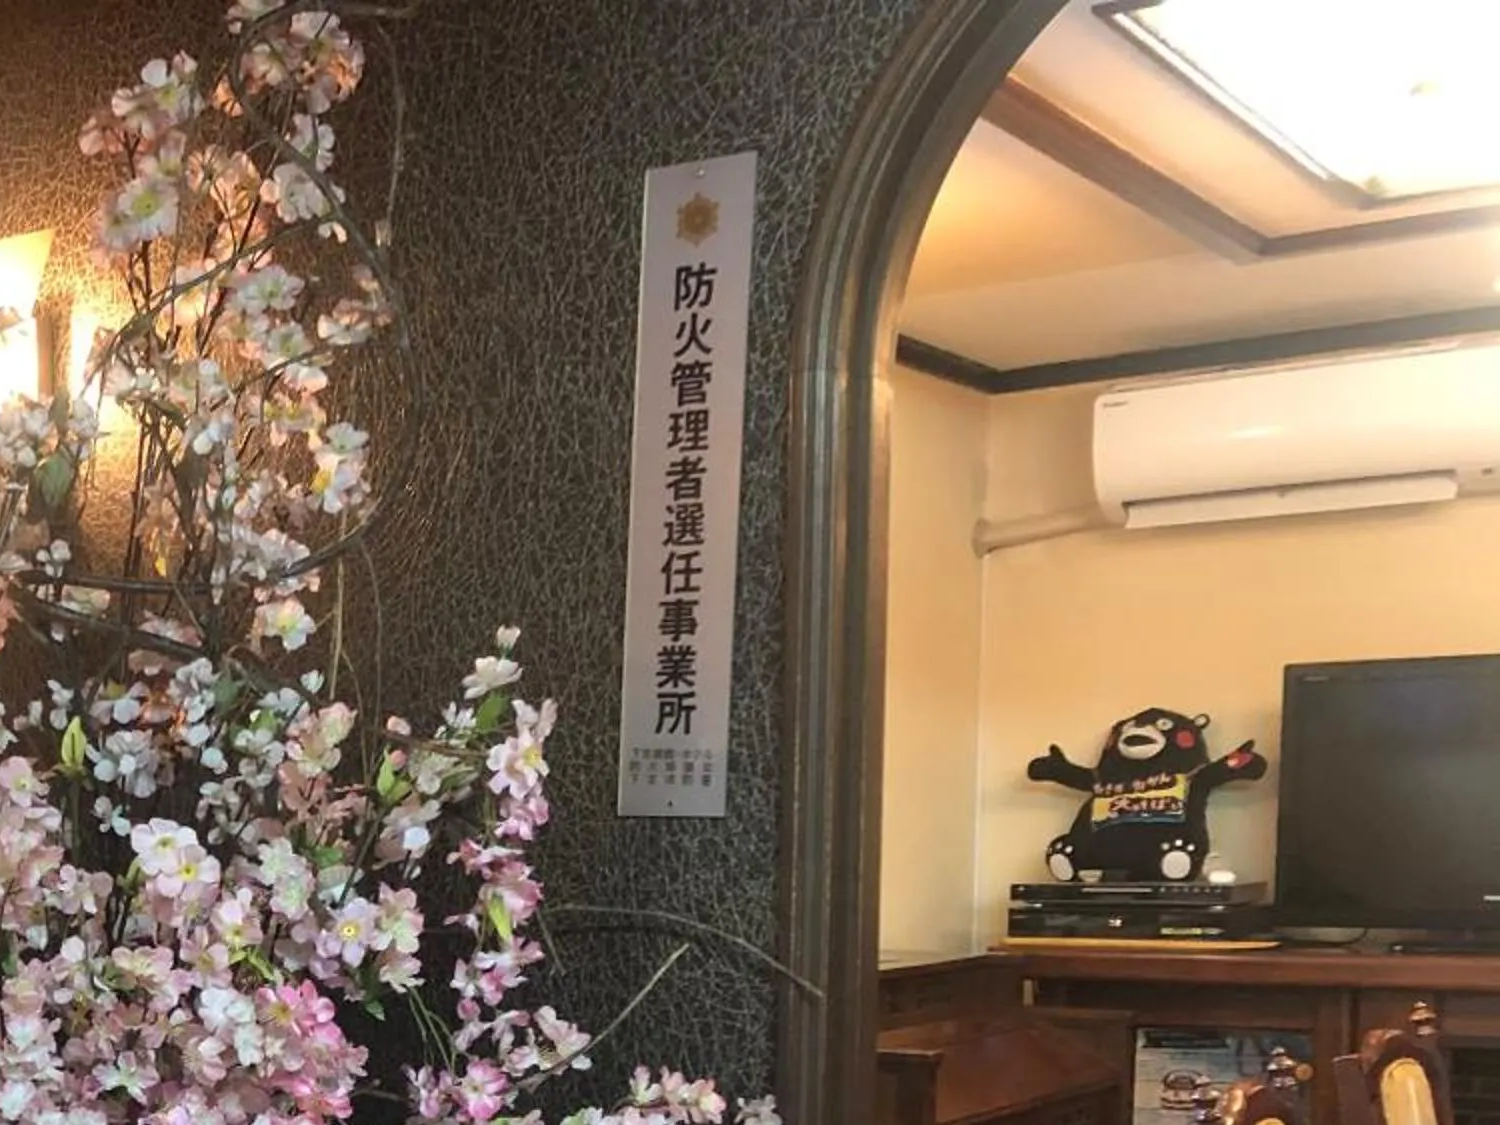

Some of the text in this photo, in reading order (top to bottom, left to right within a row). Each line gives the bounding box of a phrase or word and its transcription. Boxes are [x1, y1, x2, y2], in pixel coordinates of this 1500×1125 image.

[655, 262, 718, 736] 防火管理者選任事業所
